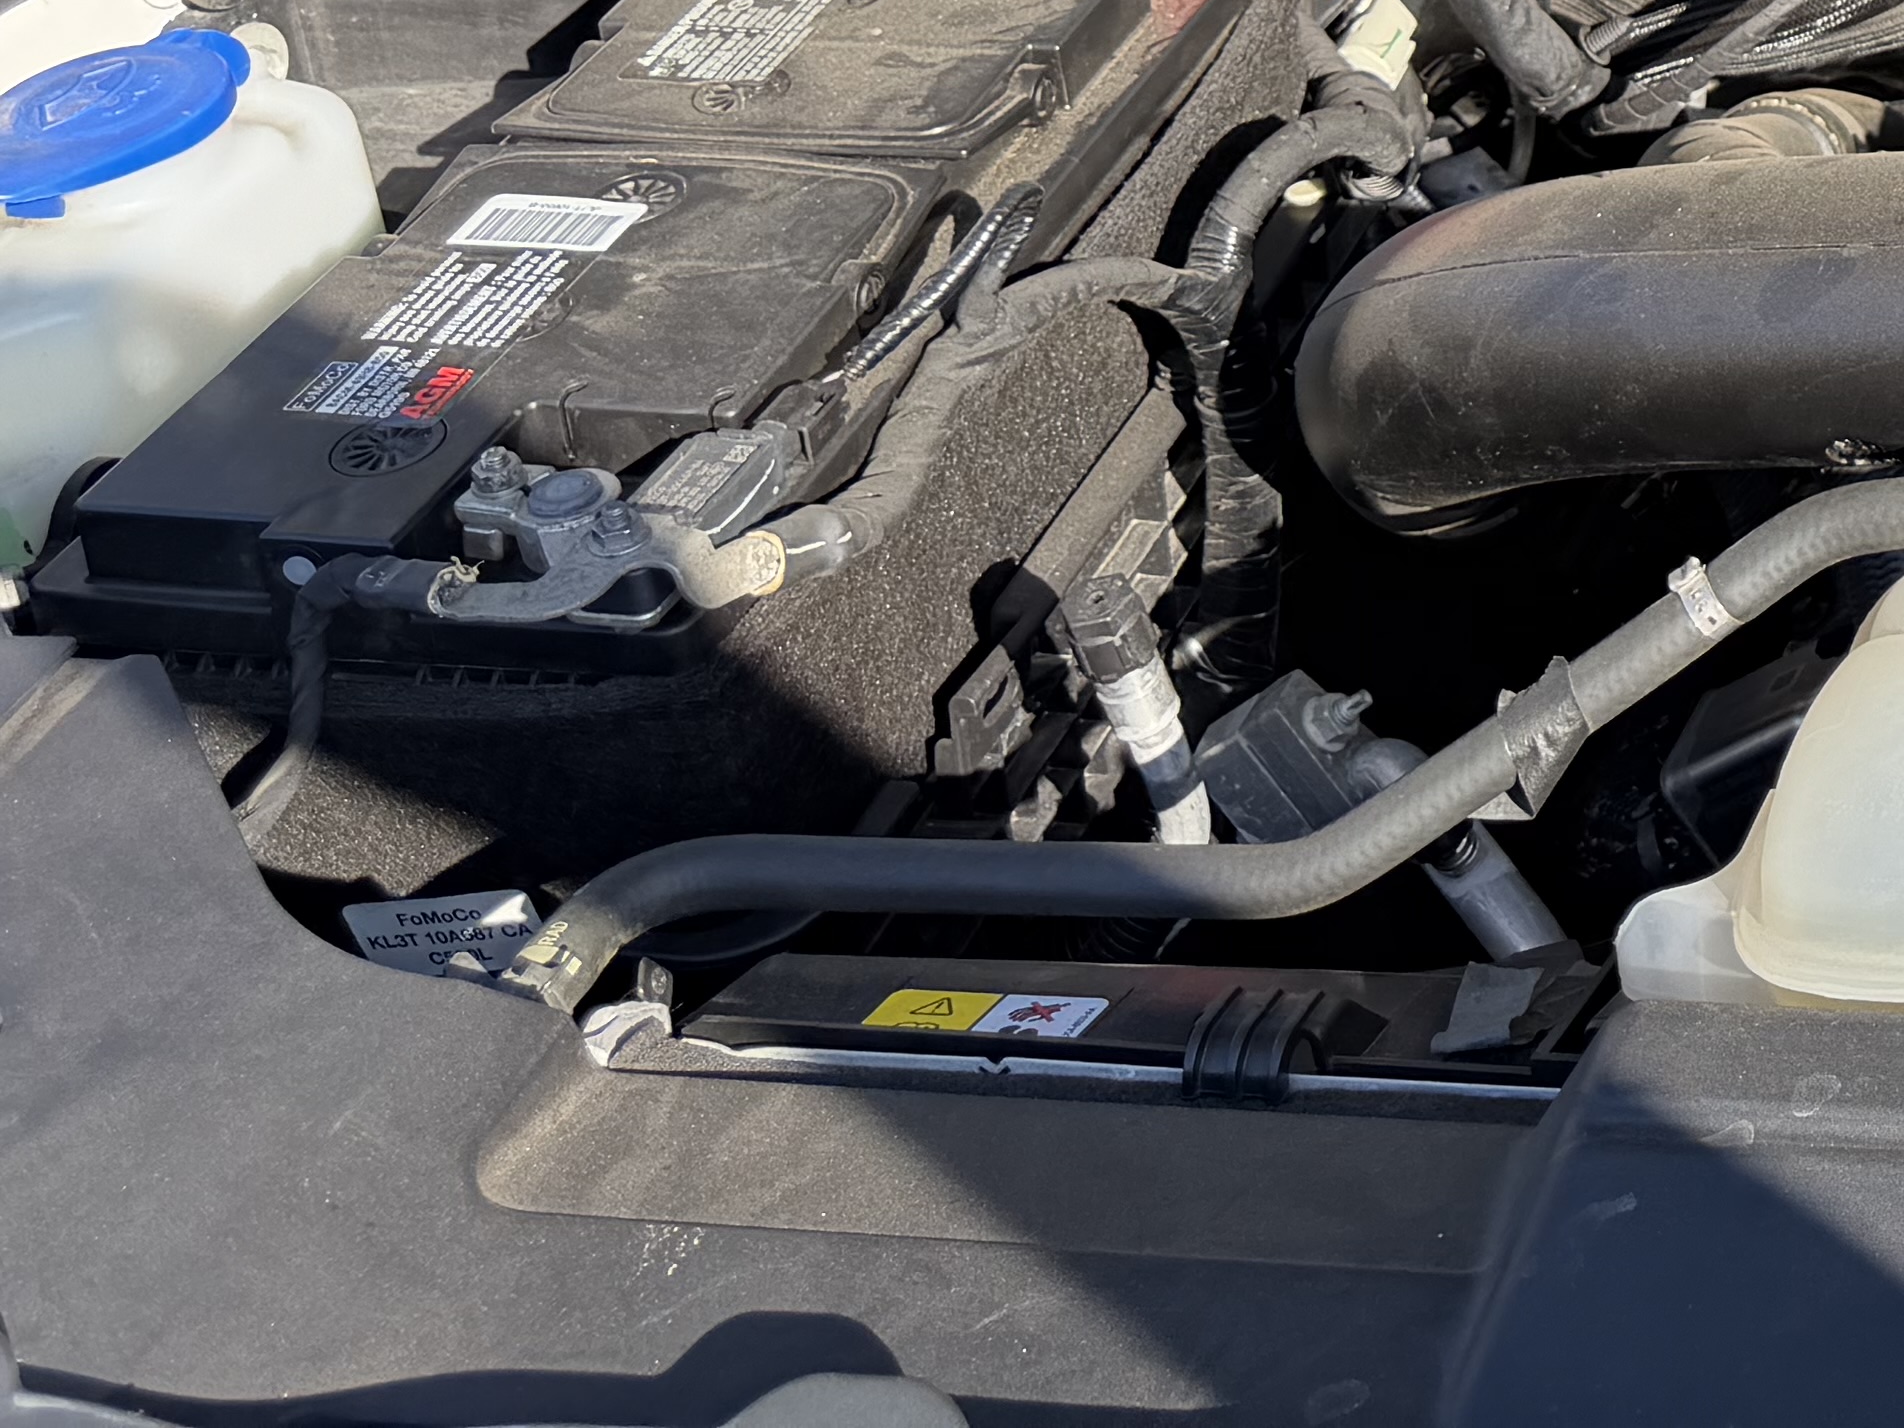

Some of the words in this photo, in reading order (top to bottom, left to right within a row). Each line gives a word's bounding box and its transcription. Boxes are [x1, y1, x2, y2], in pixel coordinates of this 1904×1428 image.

[292, 364, 352, 410] FoMoCo
[400, 367, 466, 419] AGM
[396, 907, 481, 928] FoMoCo
[367, 932, 419, 950] KL3T
[501, 923, 533, 939] CA
[538, 920, 569, 946] RAD
